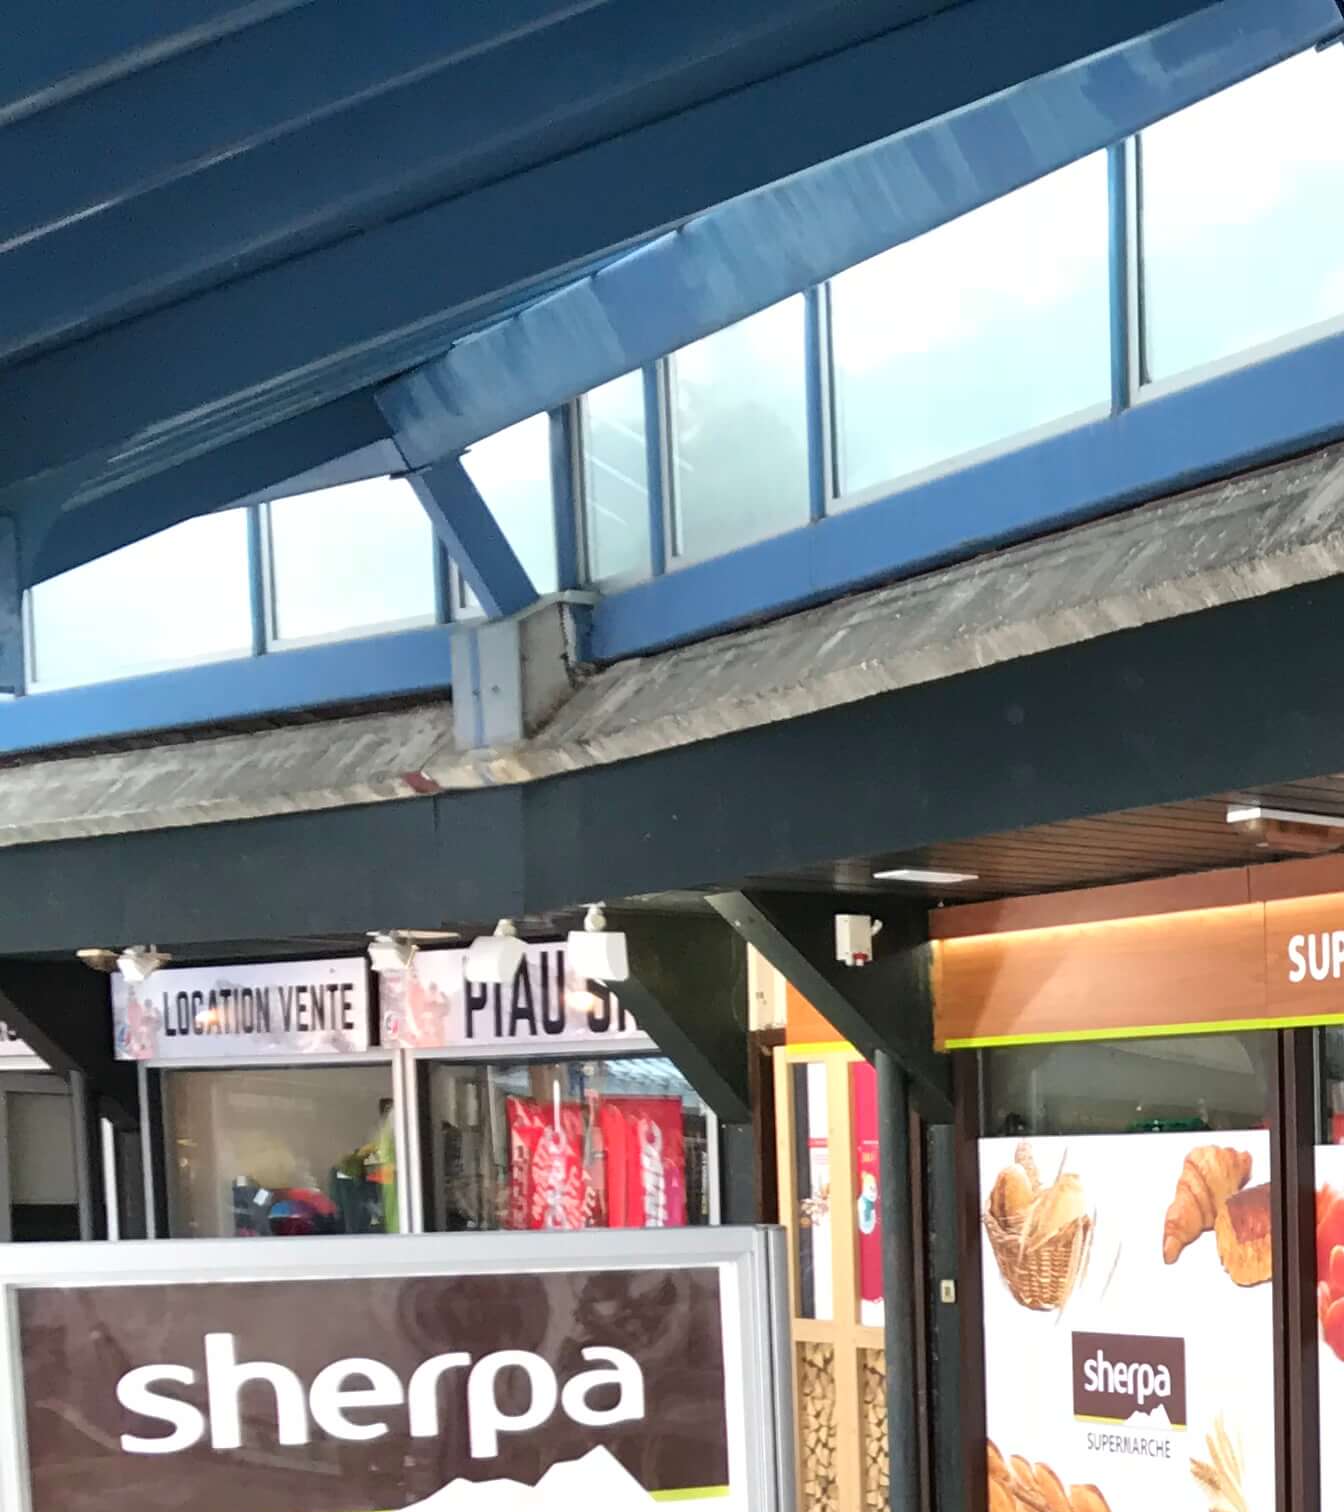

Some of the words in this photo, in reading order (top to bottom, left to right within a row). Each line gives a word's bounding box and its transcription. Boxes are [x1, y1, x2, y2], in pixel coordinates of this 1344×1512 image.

[163, 986, 271, 1037] LOCATION
[278, 983, 355, 1033] VENTE
[463, 950, 565, 1038] PIAU
[116, 1331, 646, 1459] sherpa
[1084, 1349, 1171, 1405] sherpa
